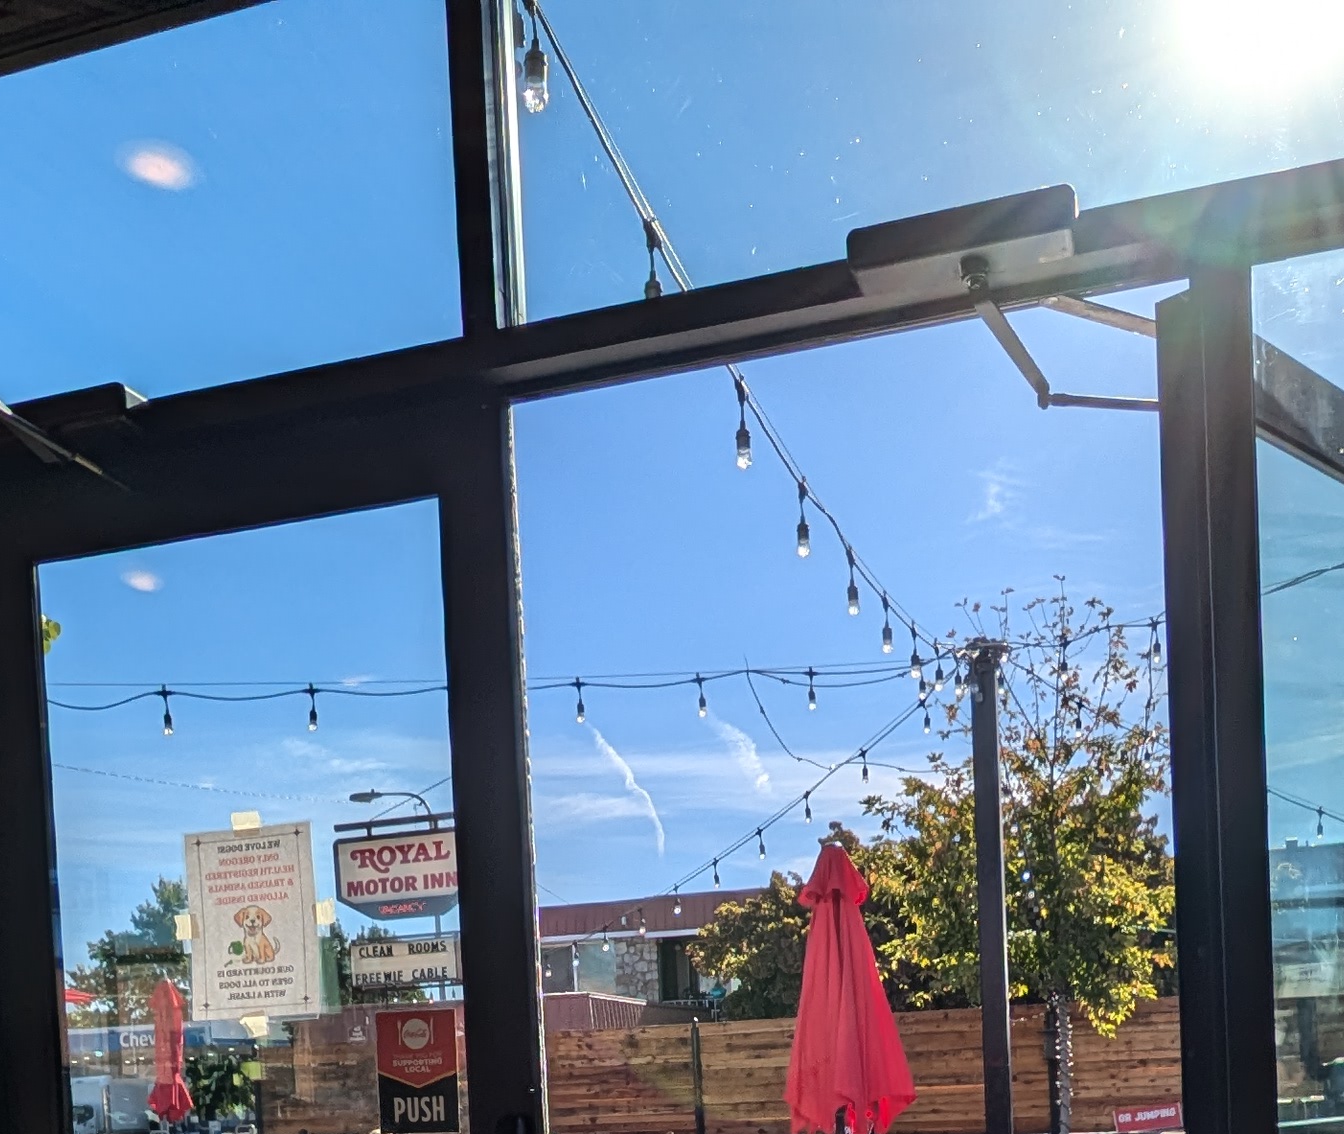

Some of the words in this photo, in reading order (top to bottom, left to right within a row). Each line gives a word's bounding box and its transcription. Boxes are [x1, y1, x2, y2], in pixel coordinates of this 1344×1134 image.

[349, 840, 451, 874] ROYAL
[347, 876, 418, 897] MOTOR
[423, 871, 458, 890] INN
[358, 945, 393, 958] CLEAN
[408, 940, 448, 955] ROOMS
[412, 967, 448, 979] CABLE
[119, 1030, 155, 1049] Chev
[404, 1065, 431, 1073] LOCAL
[393, 1095, 445, 1123] PUSH
[1118, 1113, 1132, 1123] OR
[1134, 1107, 1176, 1121] JUMPING
